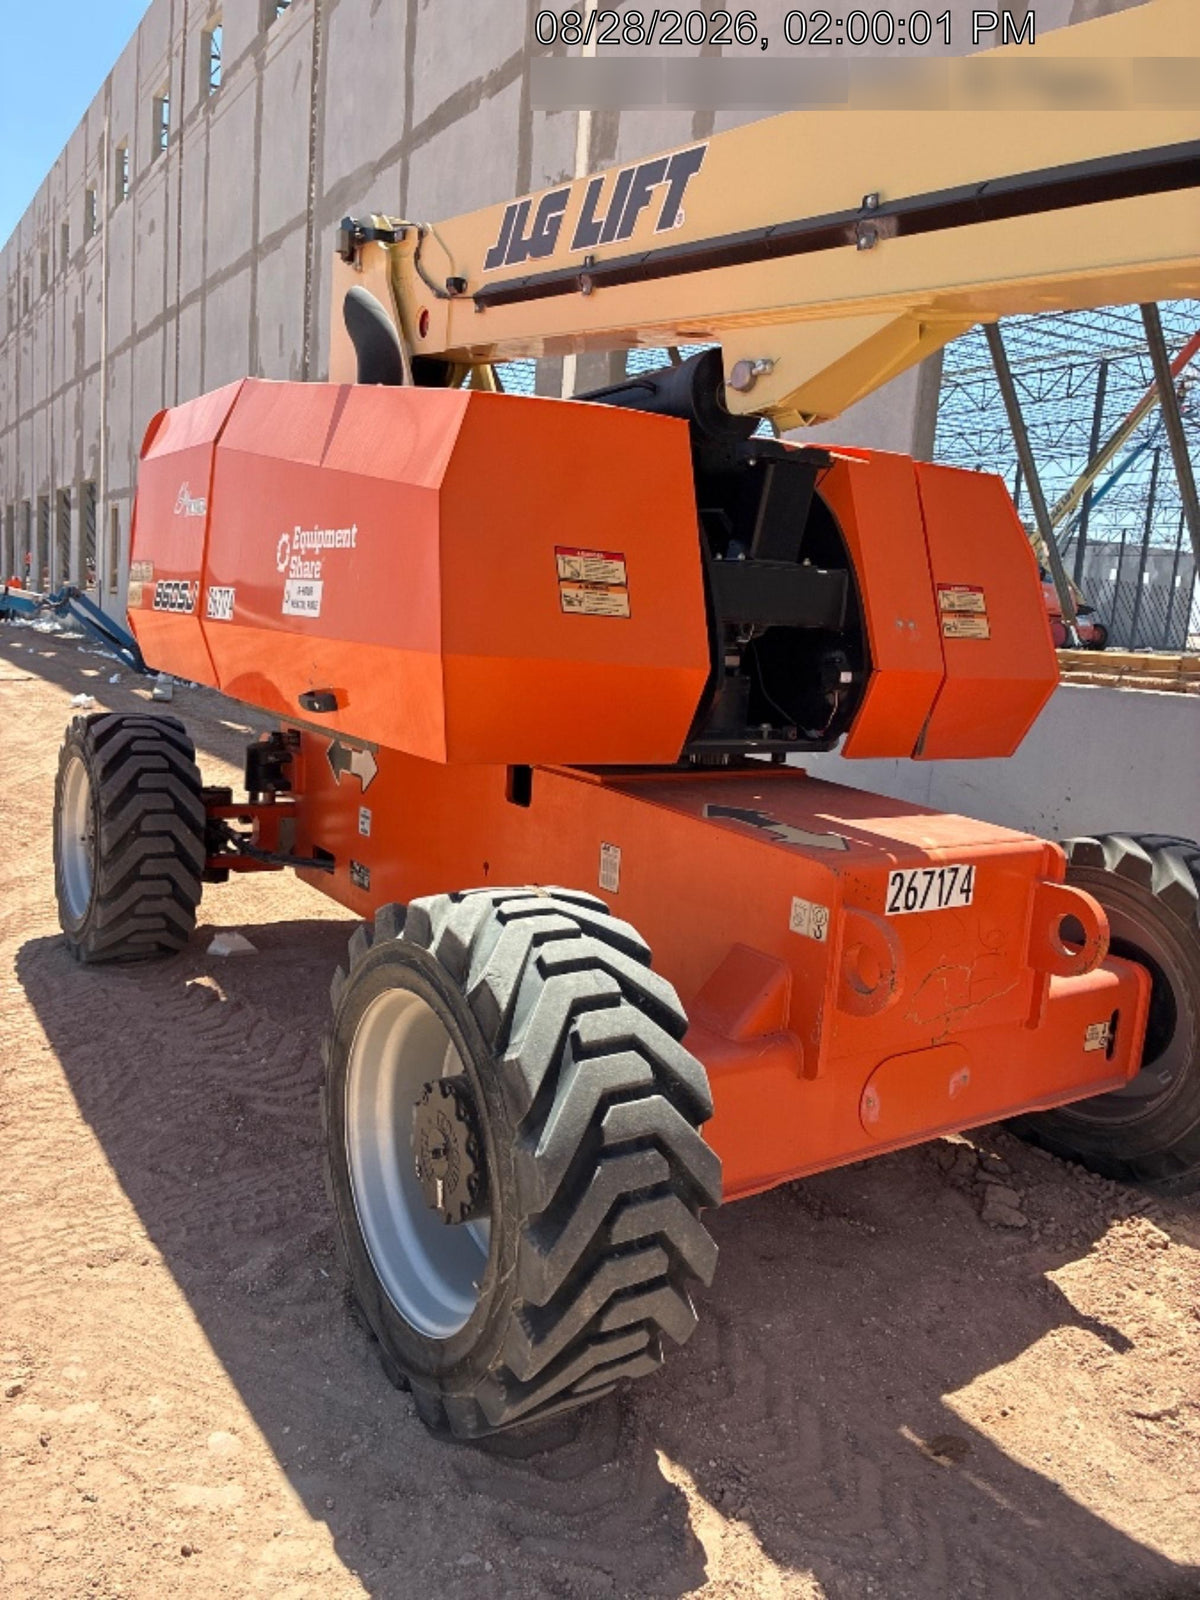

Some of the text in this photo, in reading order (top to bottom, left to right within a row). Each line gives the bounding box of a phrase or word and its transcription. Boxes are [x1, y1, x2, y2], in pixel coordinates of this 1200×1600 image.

[483, 142, 709, 271] JLG LIFT
[292, 524, 358, 555] Equipment
[289, 556, 322, 579] Share
[887, 866, 973, 913] 267174
